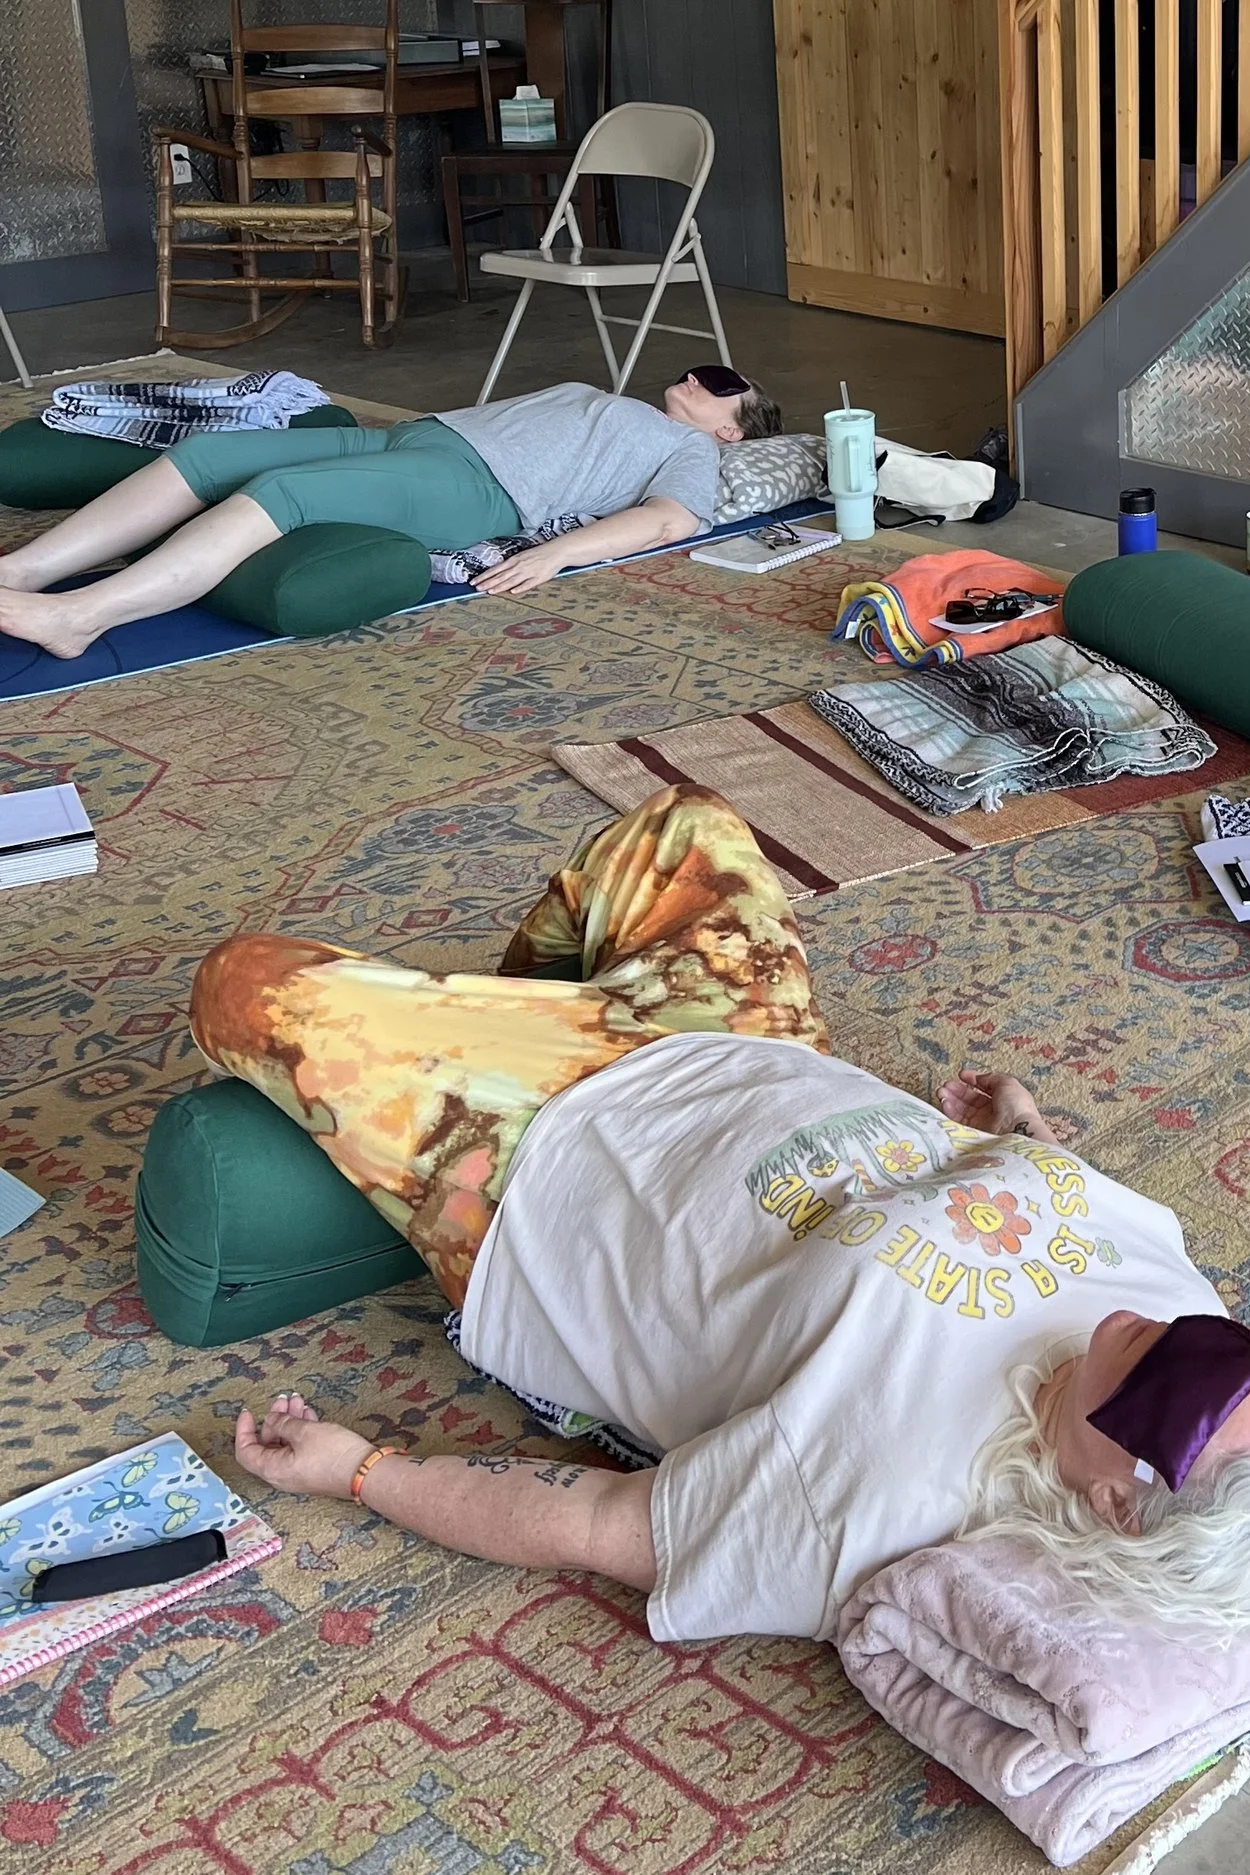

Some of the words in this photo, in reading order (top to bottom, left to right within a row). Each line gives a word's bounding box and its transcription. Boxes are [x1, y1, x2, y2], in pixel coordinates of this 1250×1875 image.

[820, 1206, 888, 1247] OF
[1047, 1225, 1096, 1275] IS
[874, 1224, 1016, 1319] STATE
[1021, 1259, 1059, 1299] A
[561, 1467, 592, 1488] now
